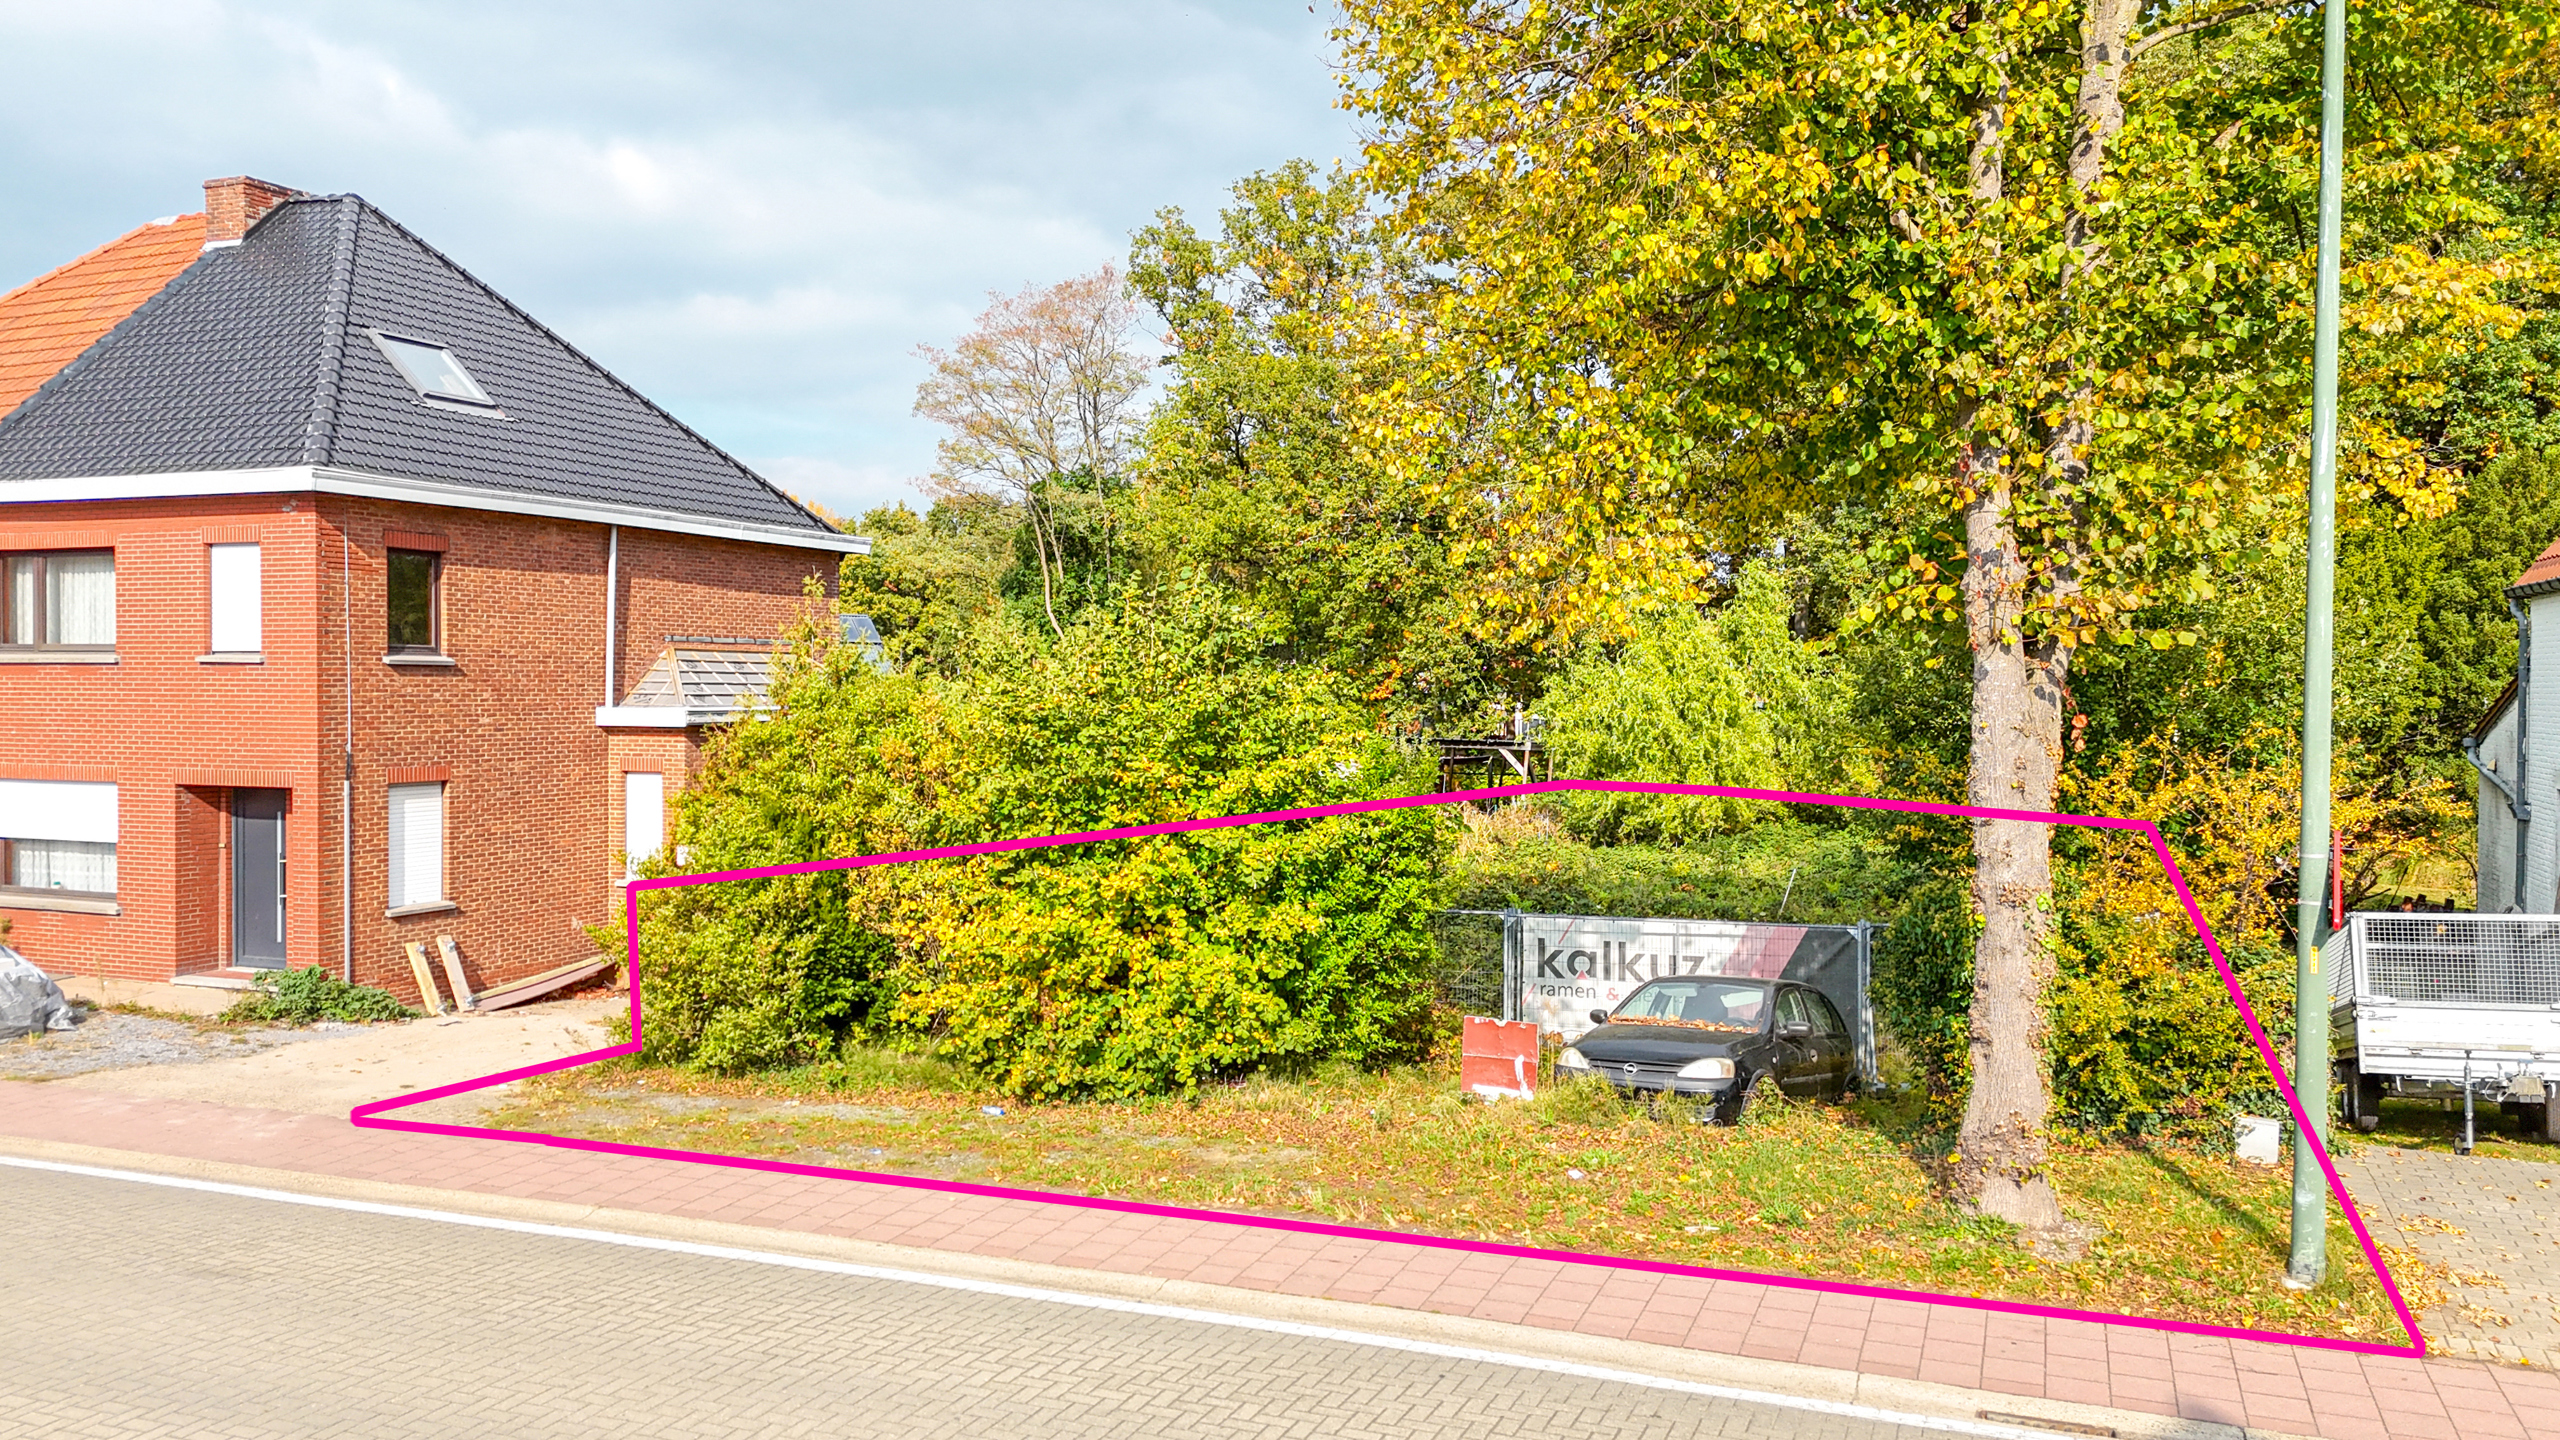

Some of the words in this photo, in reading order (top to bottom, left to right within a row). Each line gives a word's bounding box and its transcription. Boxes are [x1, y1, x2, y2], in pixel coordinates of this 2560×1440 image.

[1537, 937, 1705, 982] kalkuz
[1540, 984, 1596, 998] ramen
[1606, 988, 1620, 1001] &
